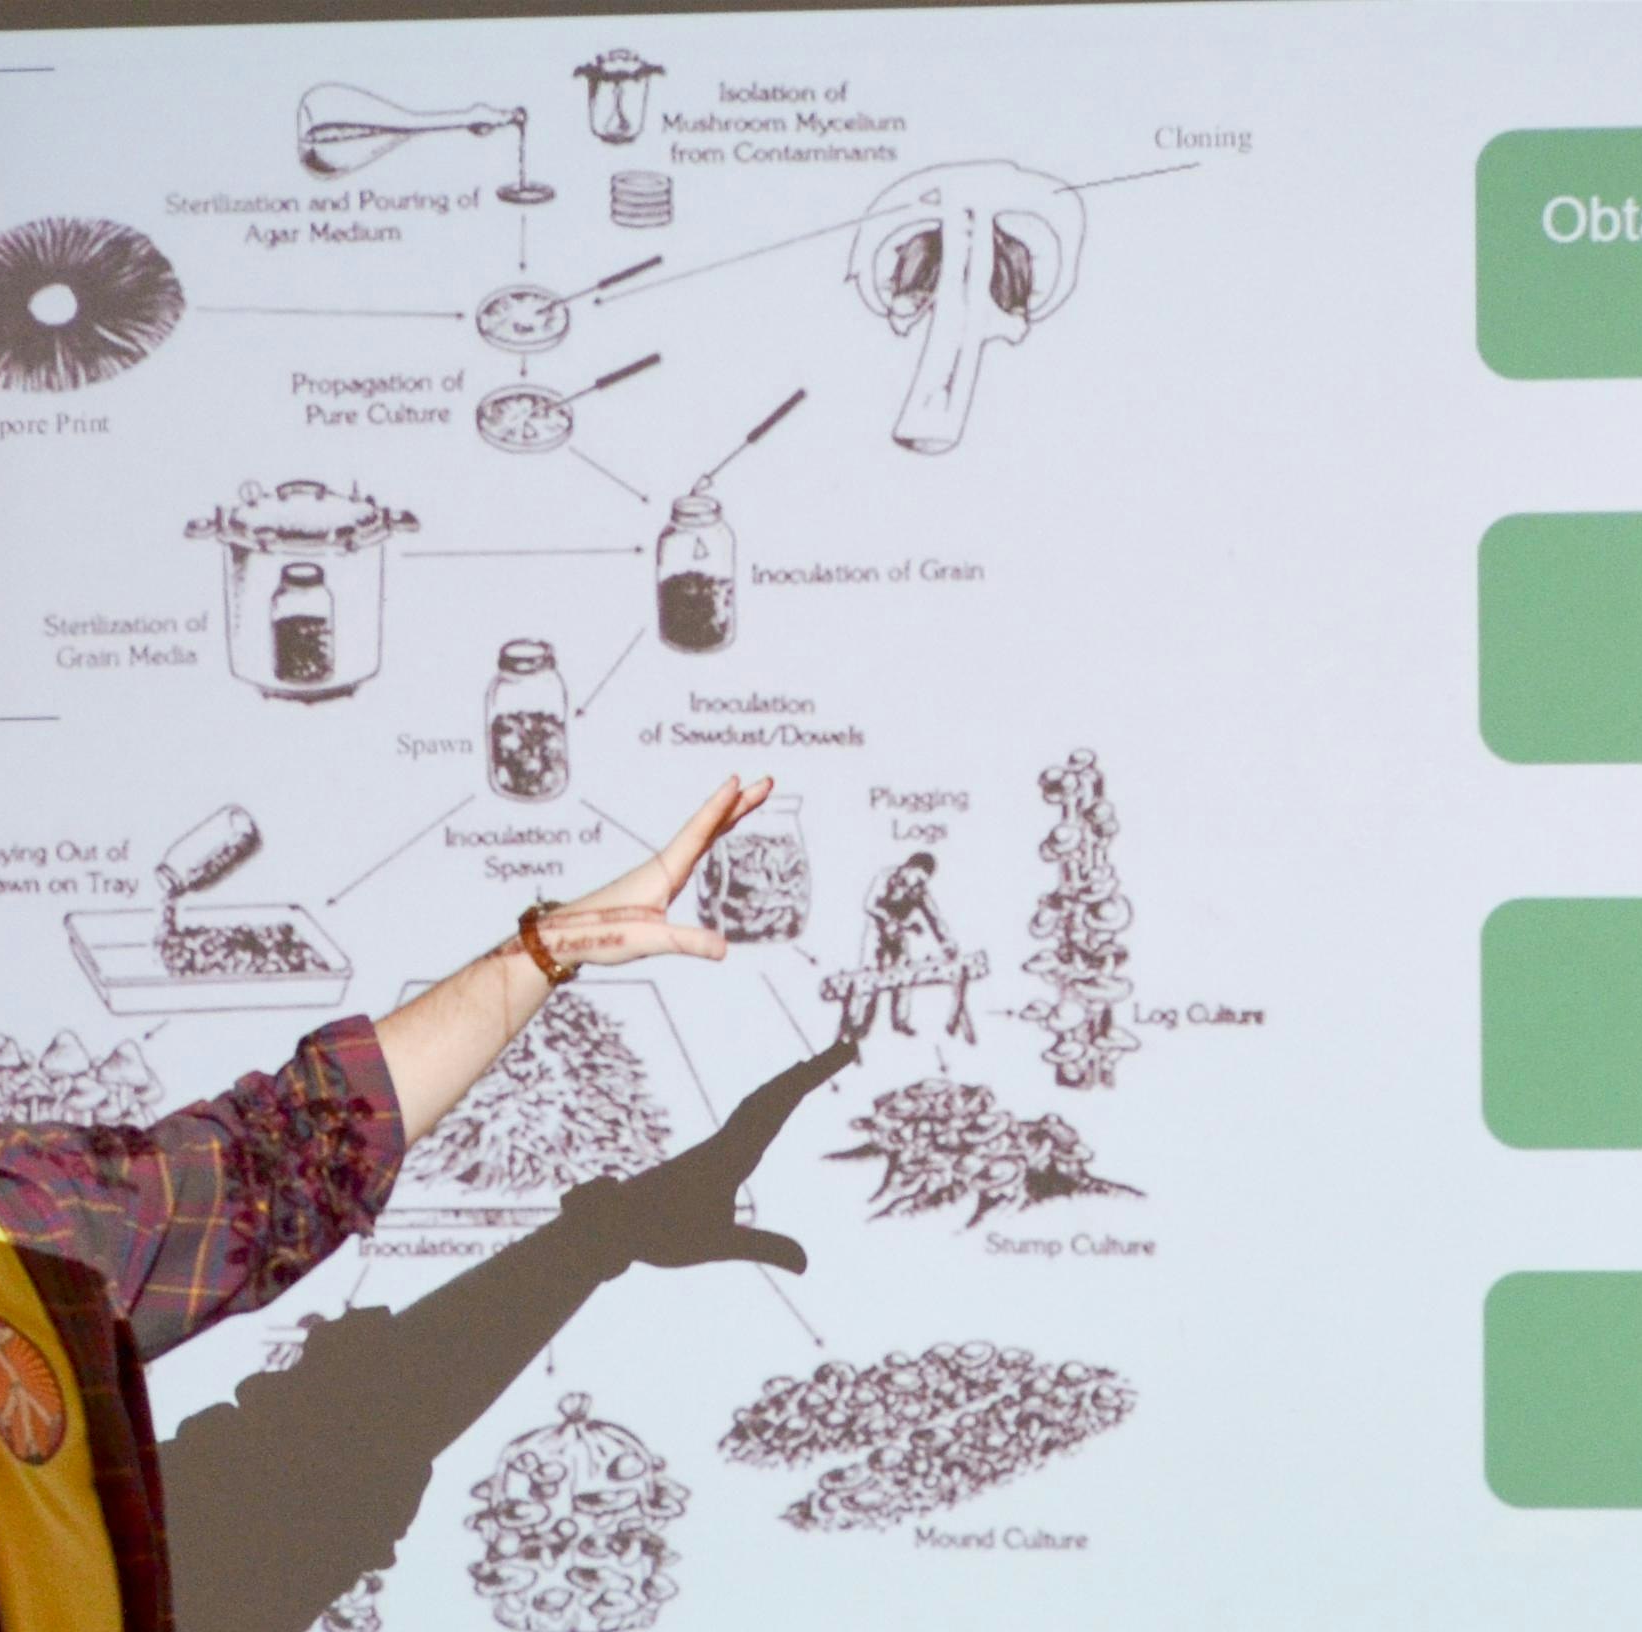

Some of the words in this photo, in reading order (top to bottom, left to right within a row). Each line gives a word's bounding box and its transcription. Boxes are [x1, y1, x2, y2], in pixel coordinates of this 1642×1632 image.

[720, 82, 815, 103] Isolation
[824, 82, 847, 102] of
[662, 113, 786, 132] Mushroom
[796, 112, 905, 136] Mycelium
[670, 143, 724, 163] from
[733, 141, 897, 163] Contaminants
[1154, 126, 1252, 153] Cloning
[166, 194, 300, 214] Sterilization
[309, 192, 350, 212] and
[359, 189, 450, 214] Pouring
[457, 188, 480, 209] of
[247, 225, 299, 248] Agar
[310, 222, 401, 243] Medium
[292, 373, 431, 398] Propagation
[441, 370, 464, 392] of
[56, 413, 109, 434] Print
[306, 404, 358, 425] Pure
[367, 403, 450, 424] Culture
[752, 564, 879, 584] Inoculation
[887, 559, 911, 582] of
[919, 559, 984, 580] Grain
[44, 614, 177, 637] Sterilization
[185, 611, 208, 633] of
[56, 647, 120, 668] Grain
[130, 645, 197, 665] Media
[690, 692, 815, 714] Inoculation
[639, 723, 662, 744] of
[671, 723, 864, 746] Sawdust/Dowels
[397, 734, 473, 761] Spawn
[870, 787, 968, 812] Plugging
[445, 827, 569, 847] Inoculation
[579, 822, 602, 843] of
[892, 820, 948, 844] Logs
[56, 841, 97, 862] Out
[107, 839, 129, 862] of
[485, 856, 563, 881] Spawn
[48, 879, 77, 893] on
[87, 871, 138, 897] Tray
[1134, 1003, 1178, 1030] Log
[1187, 1004, 1264, 1025] Culture
[358, 1235, 485, 1257] Inoculation
[986, 1232, 1063, 1258] Stump
[1070, 1234, 1156, 1256] Culture
[915, 1527, 994, 1549] Mound
[1002, 1527, 1088, 1550] Culture
